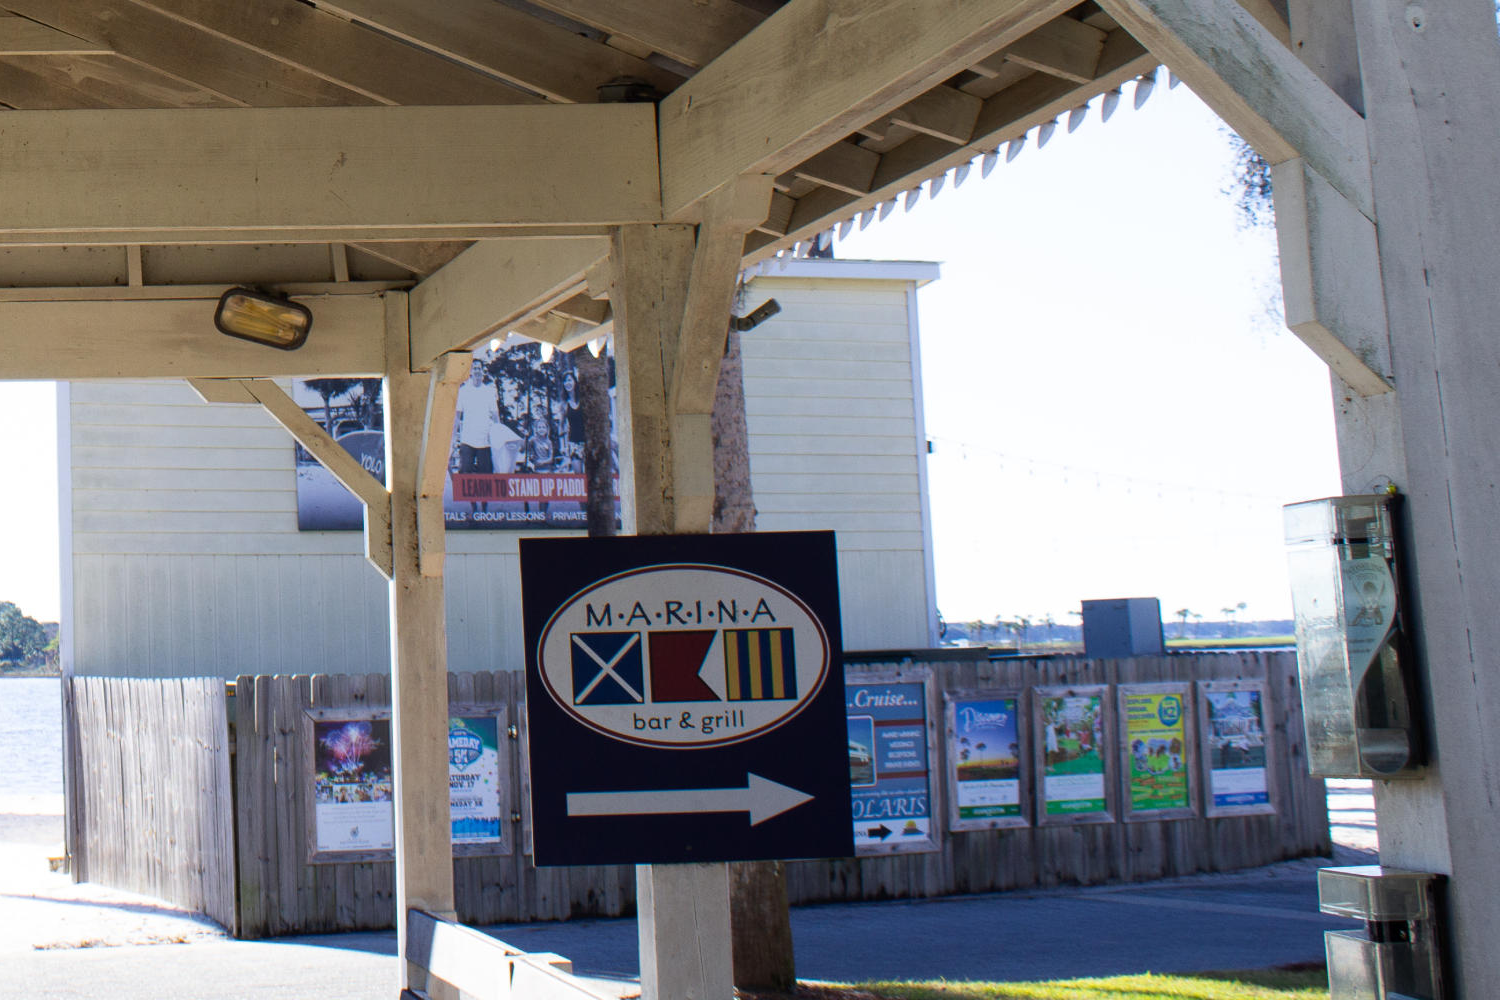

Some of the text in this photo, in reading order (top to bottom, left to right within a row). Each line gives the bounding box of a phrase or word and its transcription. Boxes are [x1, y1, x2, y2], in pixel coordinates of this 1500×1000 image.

[360, 452, 382, 474] YOLO
[462, 477, 588, 497] LEARN TO STAND UP PADDL
[444, 511, 588, 521] TALS GROUP LESSONS PRIVATE
[633, 710, 745, 734] bar & grill
[852, 796, 926, 820] OLARIS
